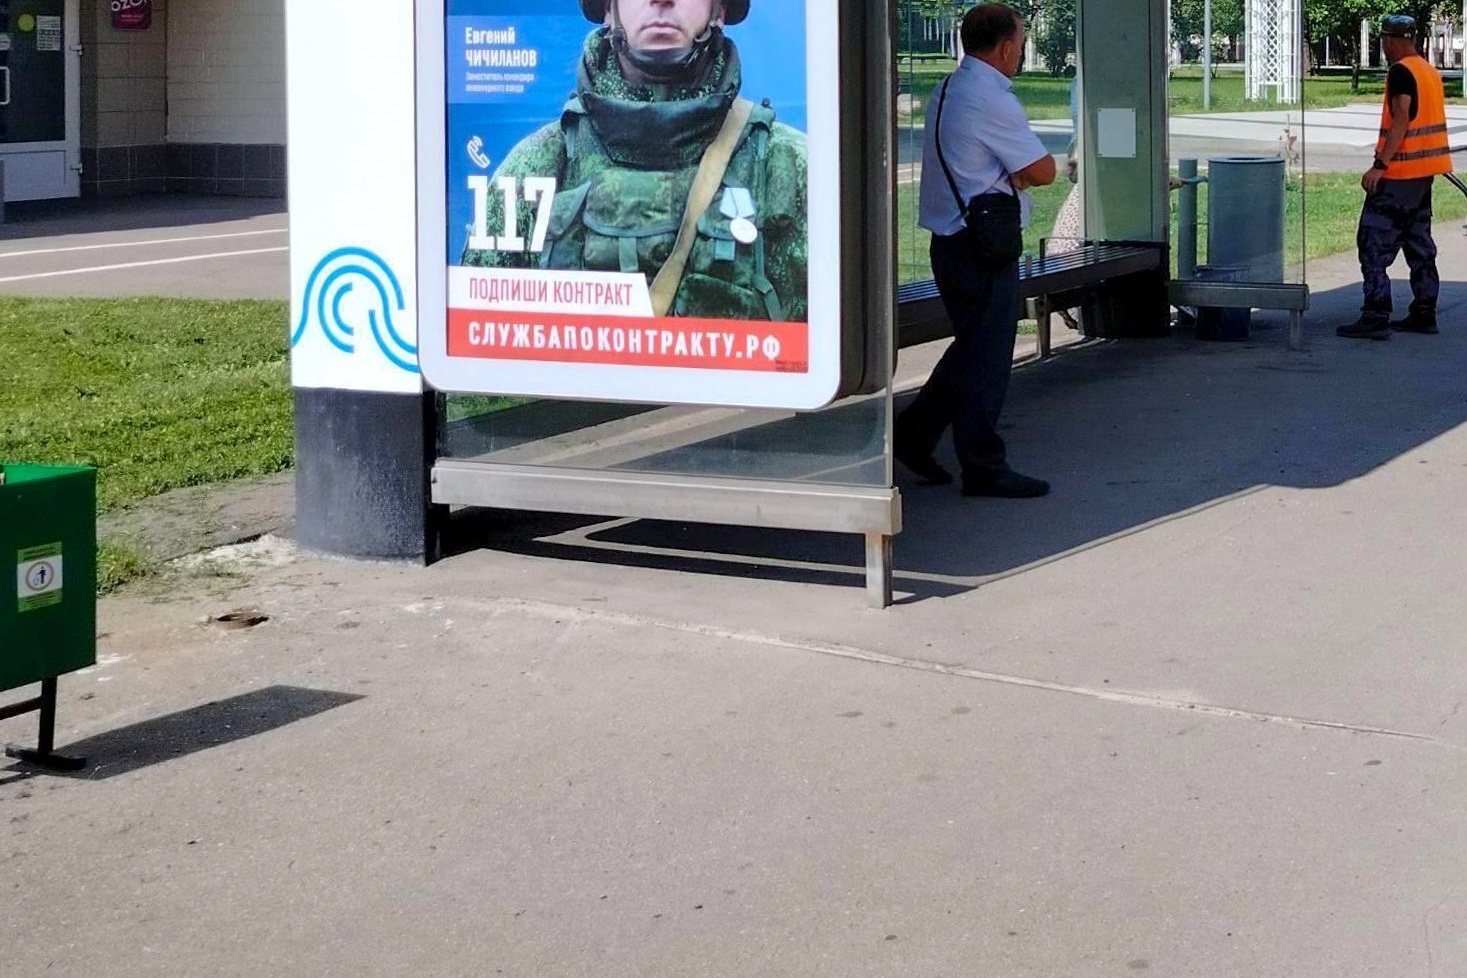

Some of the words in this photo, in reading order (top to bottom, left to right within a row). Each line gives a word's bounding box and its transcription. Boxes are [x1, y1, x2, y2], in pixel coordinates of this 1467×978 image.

[465, 26, 516, 45] Евгений
[465, 49, 537, 67] ЧИЧИЛАНОВ
[467, 175, 556, 252] 117
[469, 277, 548, 303] ПОДПИШИ
[553, 281, 633, 306] КОНТРАКТ
[468, 321, 781, 361] СЛУЖБАПОКОНТРАКТУ.РФ
